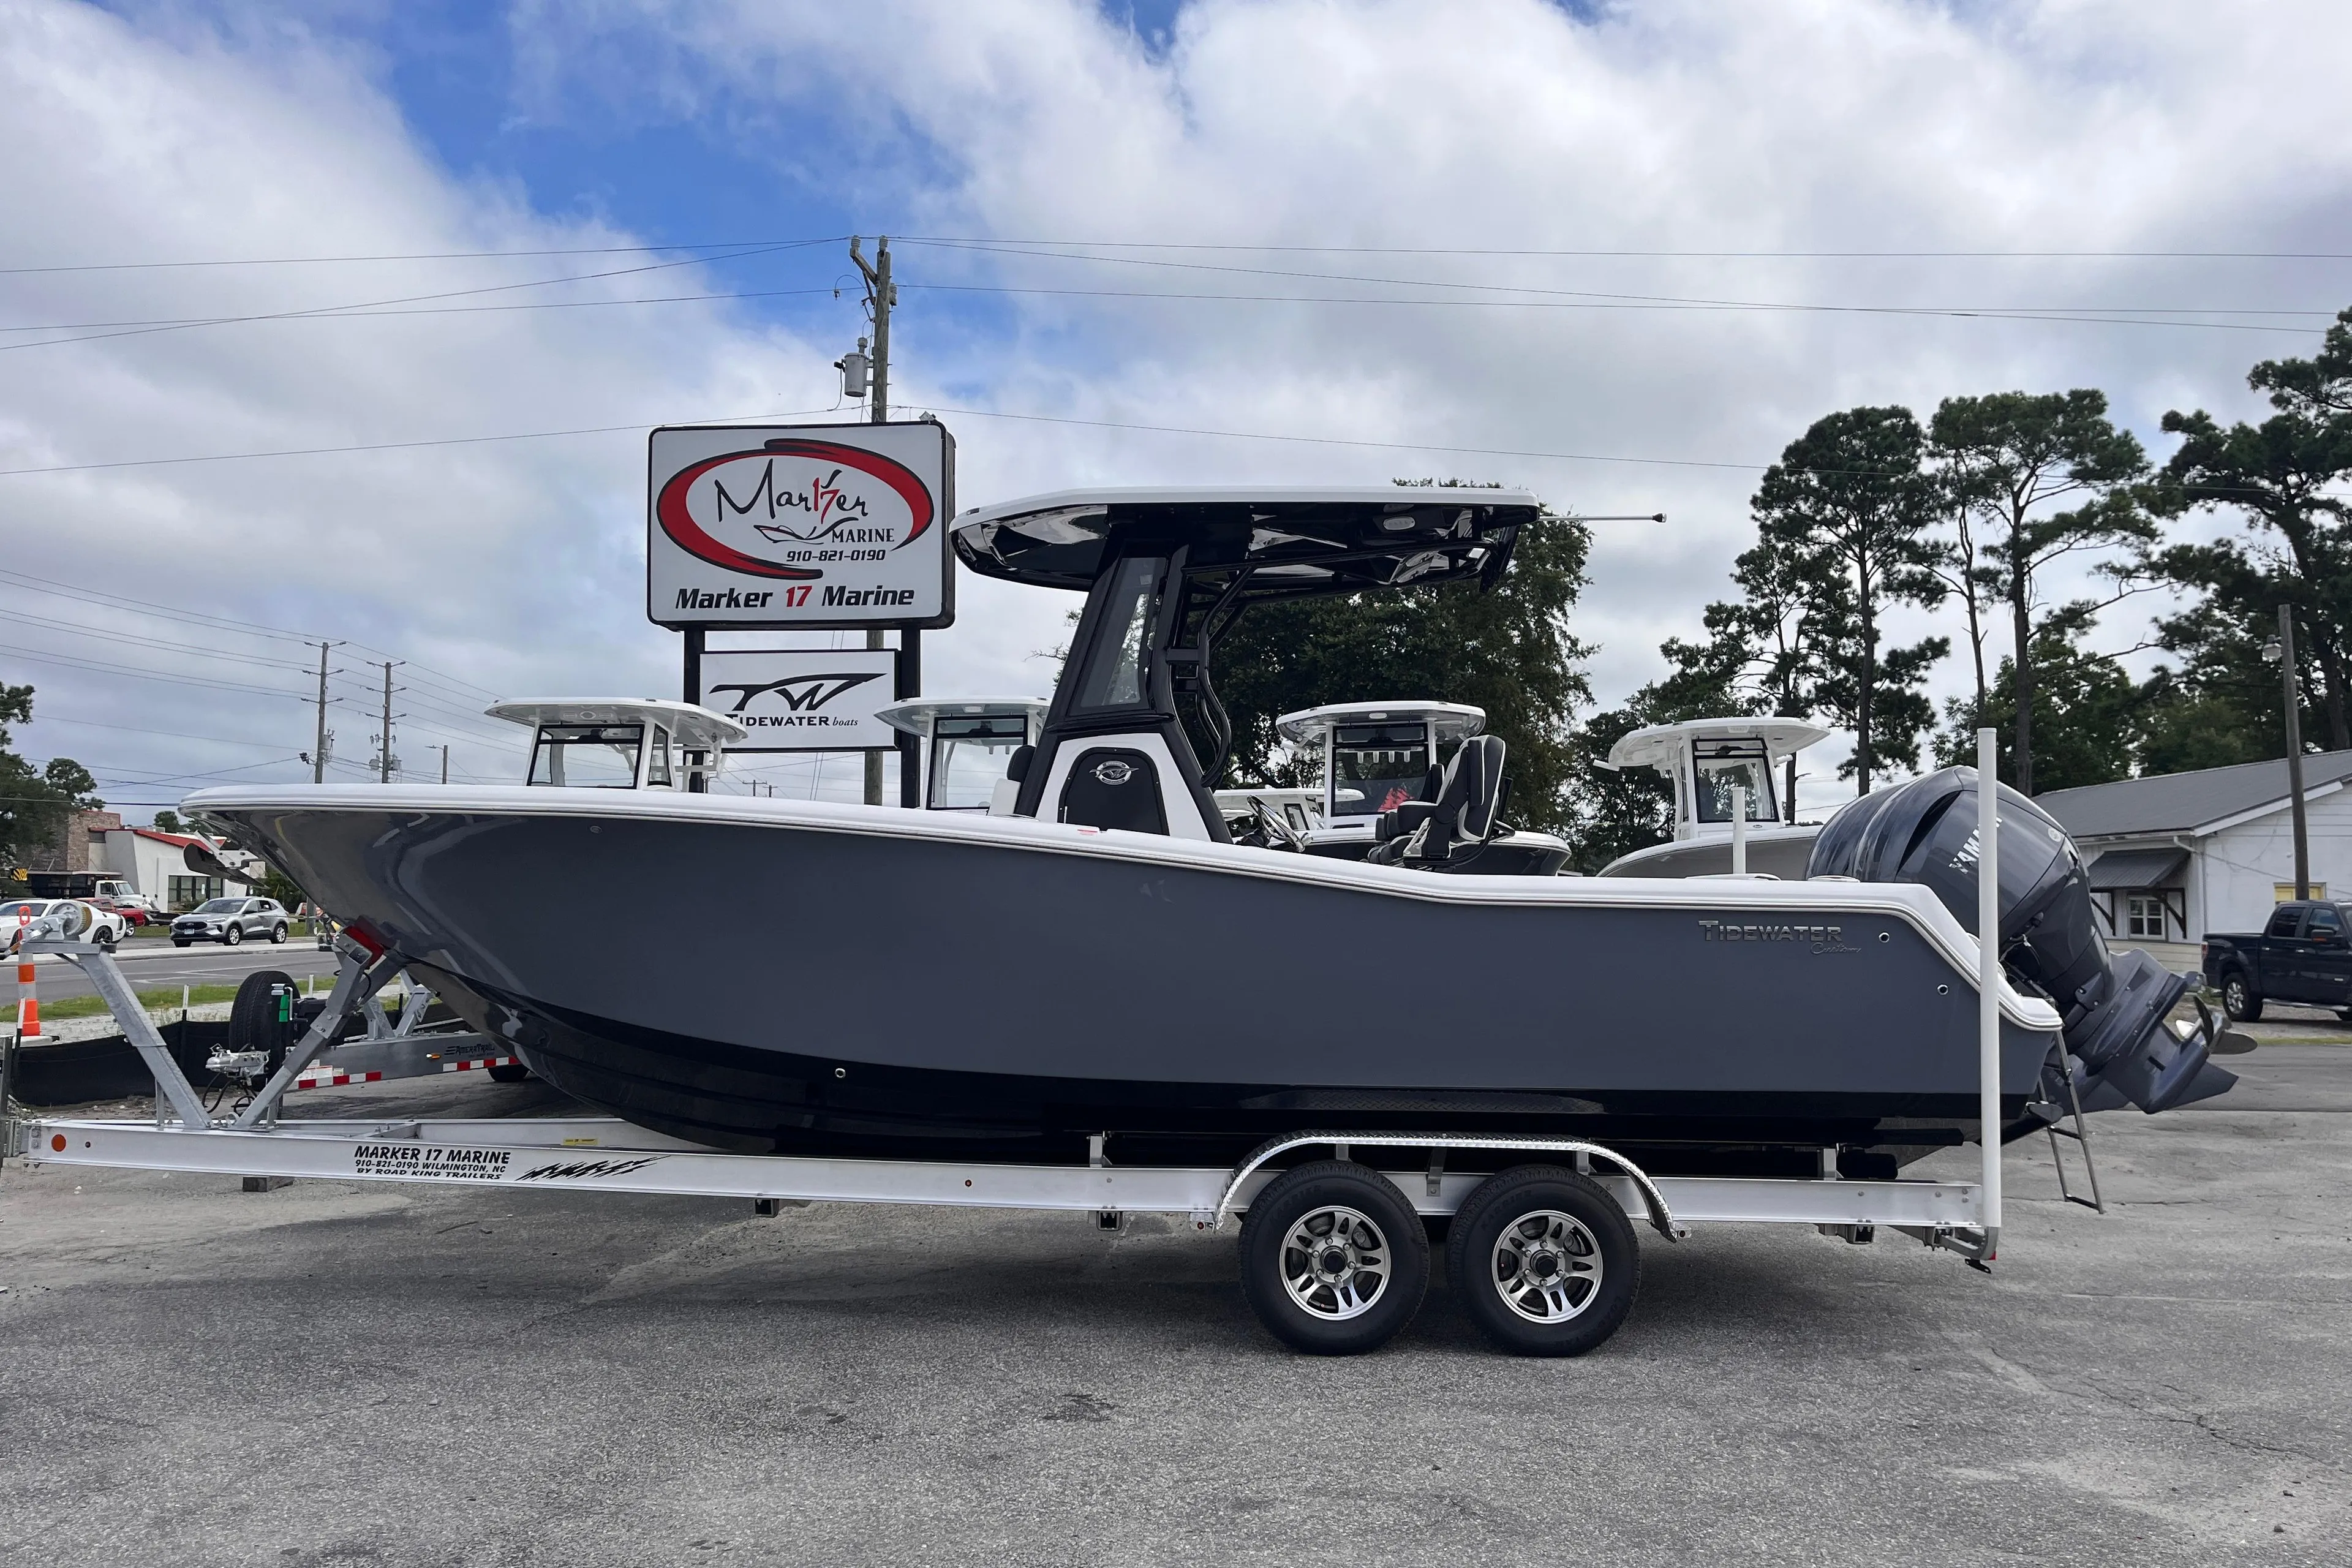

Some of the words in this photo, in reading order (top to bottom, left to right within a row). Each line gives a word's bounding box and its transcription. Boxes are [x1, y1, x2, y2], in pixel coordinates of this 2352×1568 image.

[832, 528, 895, 544] MARINE
[786, 549, 886, 562] 910-821-0190
[675, 587, 773, 610] Marker
[786, 585, 813, 608] 17
[821, 584, 914, 607] Marine
[832, 717, 858, 727] boats
[1698, 920, 1842, 942] TIDEWATER
[354, 1145, 421, 1161] MARKER
[426, 1148, 443, 1162] 17
[446, 1149, 511, 1164] MARINE
[355, 1159, 419, 1169] 910-821-0190
[422, 1162, 489, 1174] WILMINGTON,
[492, 1165, 506, 1174] NC
[446, 1171, 502, 1180] TRAILERS
